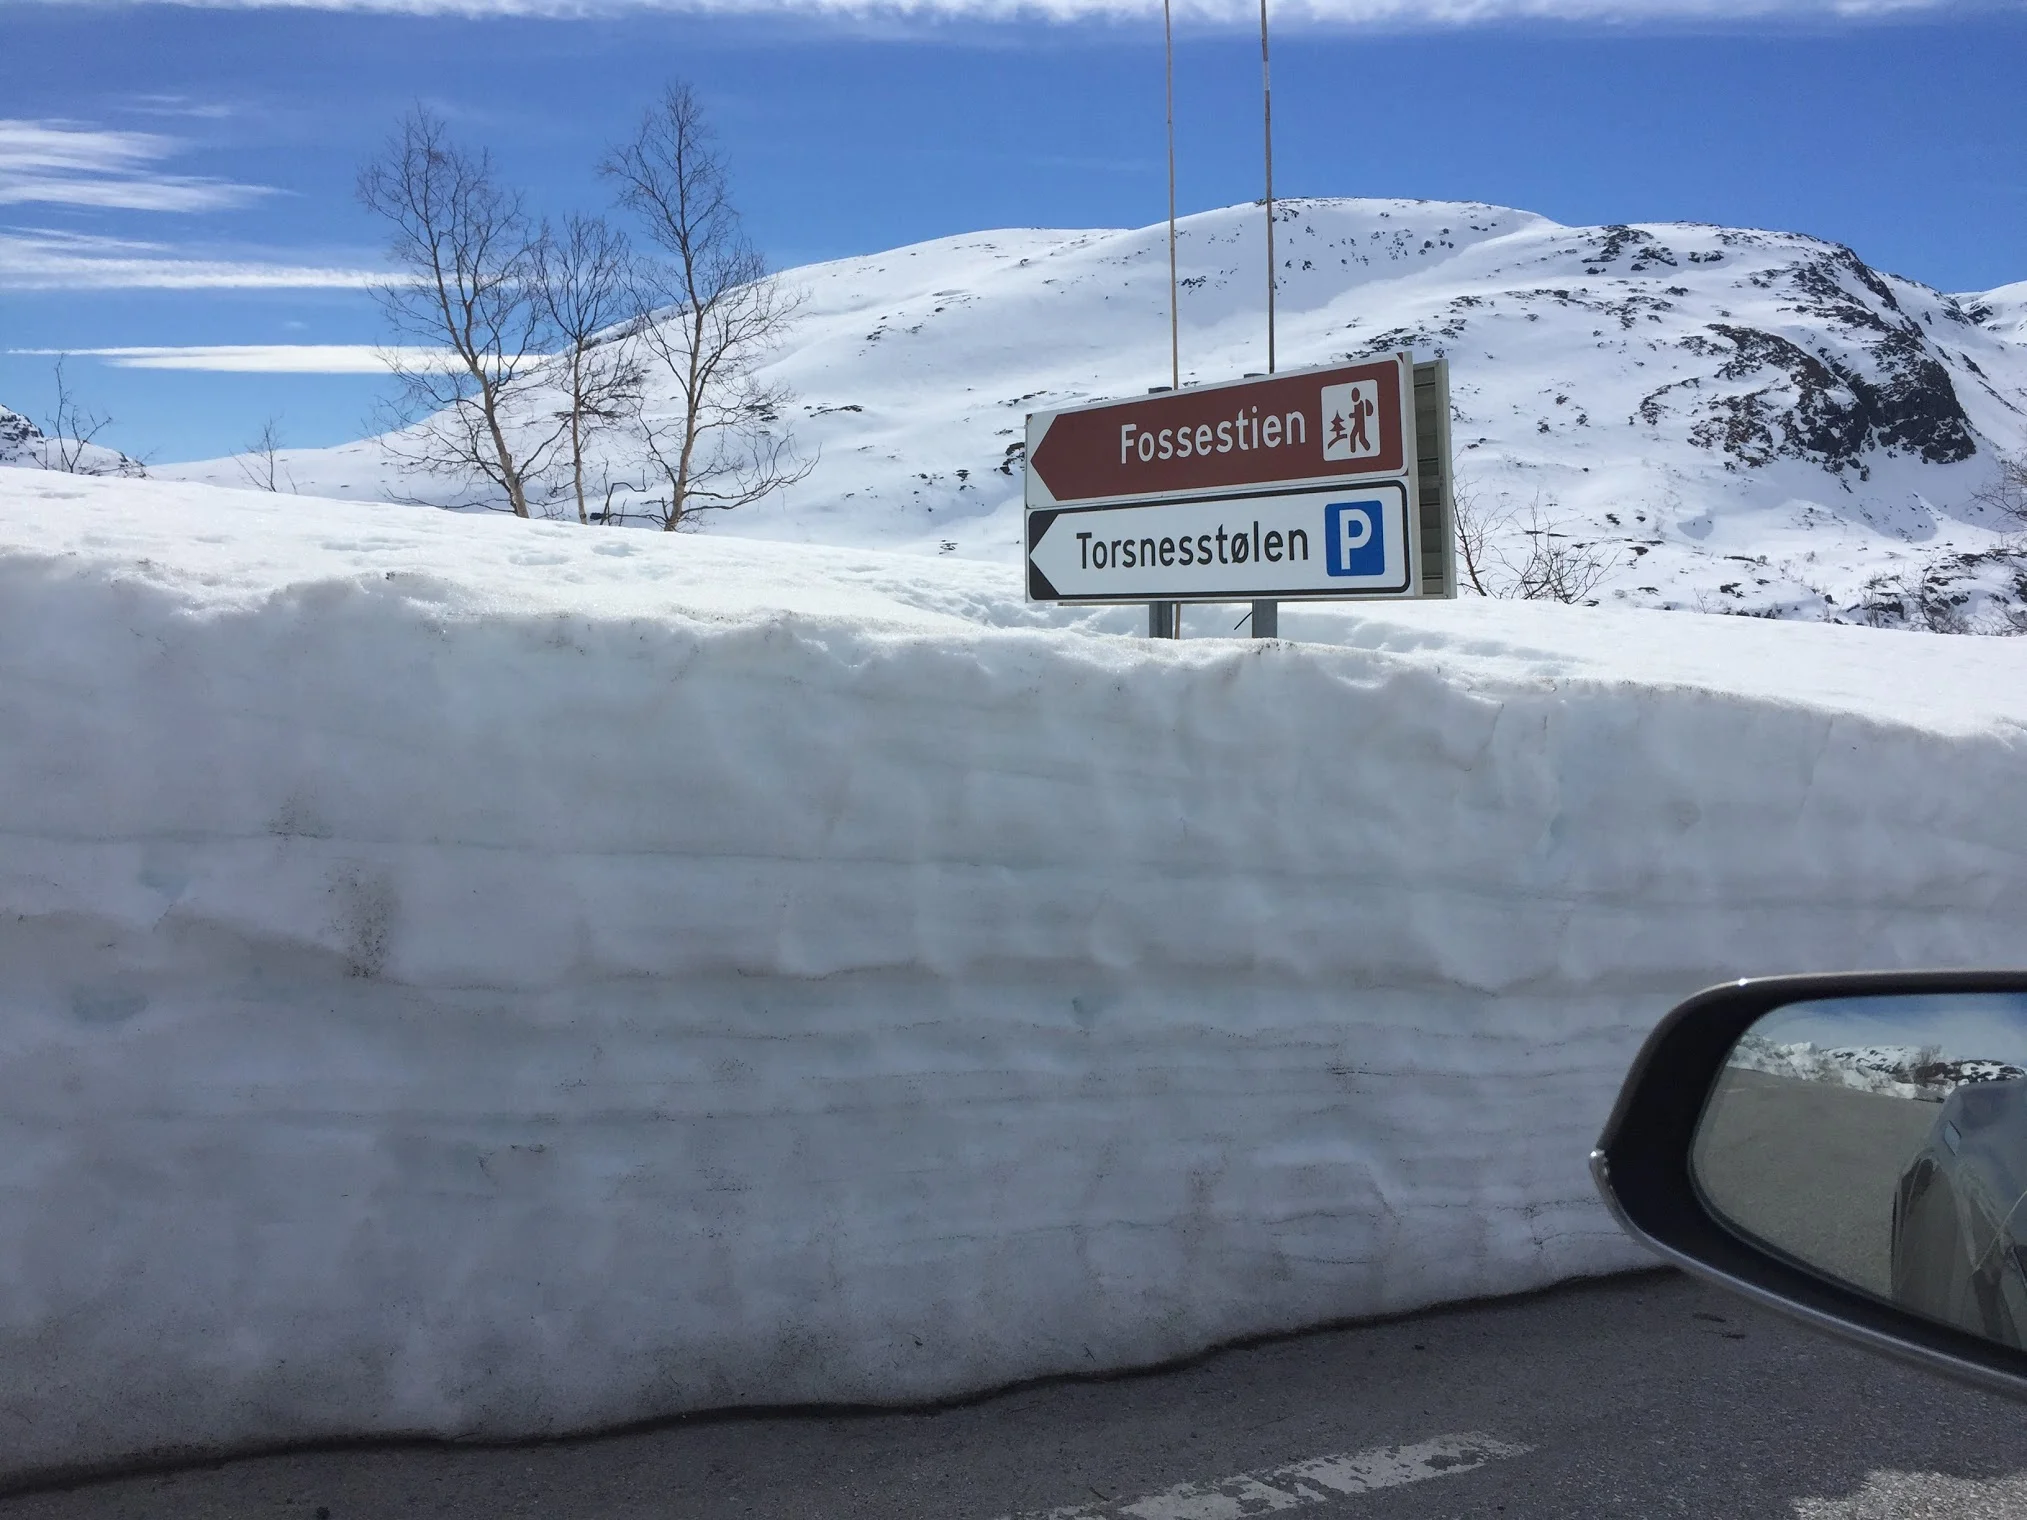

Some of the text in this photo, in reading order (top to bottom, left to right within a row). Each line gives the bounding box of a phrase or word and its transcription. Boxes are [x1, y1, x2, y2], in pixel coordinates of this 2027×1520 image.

[1120, 405, 1306, 465] Fossestien
[1076, 508, 1372, 571] Torsnesstølen P
